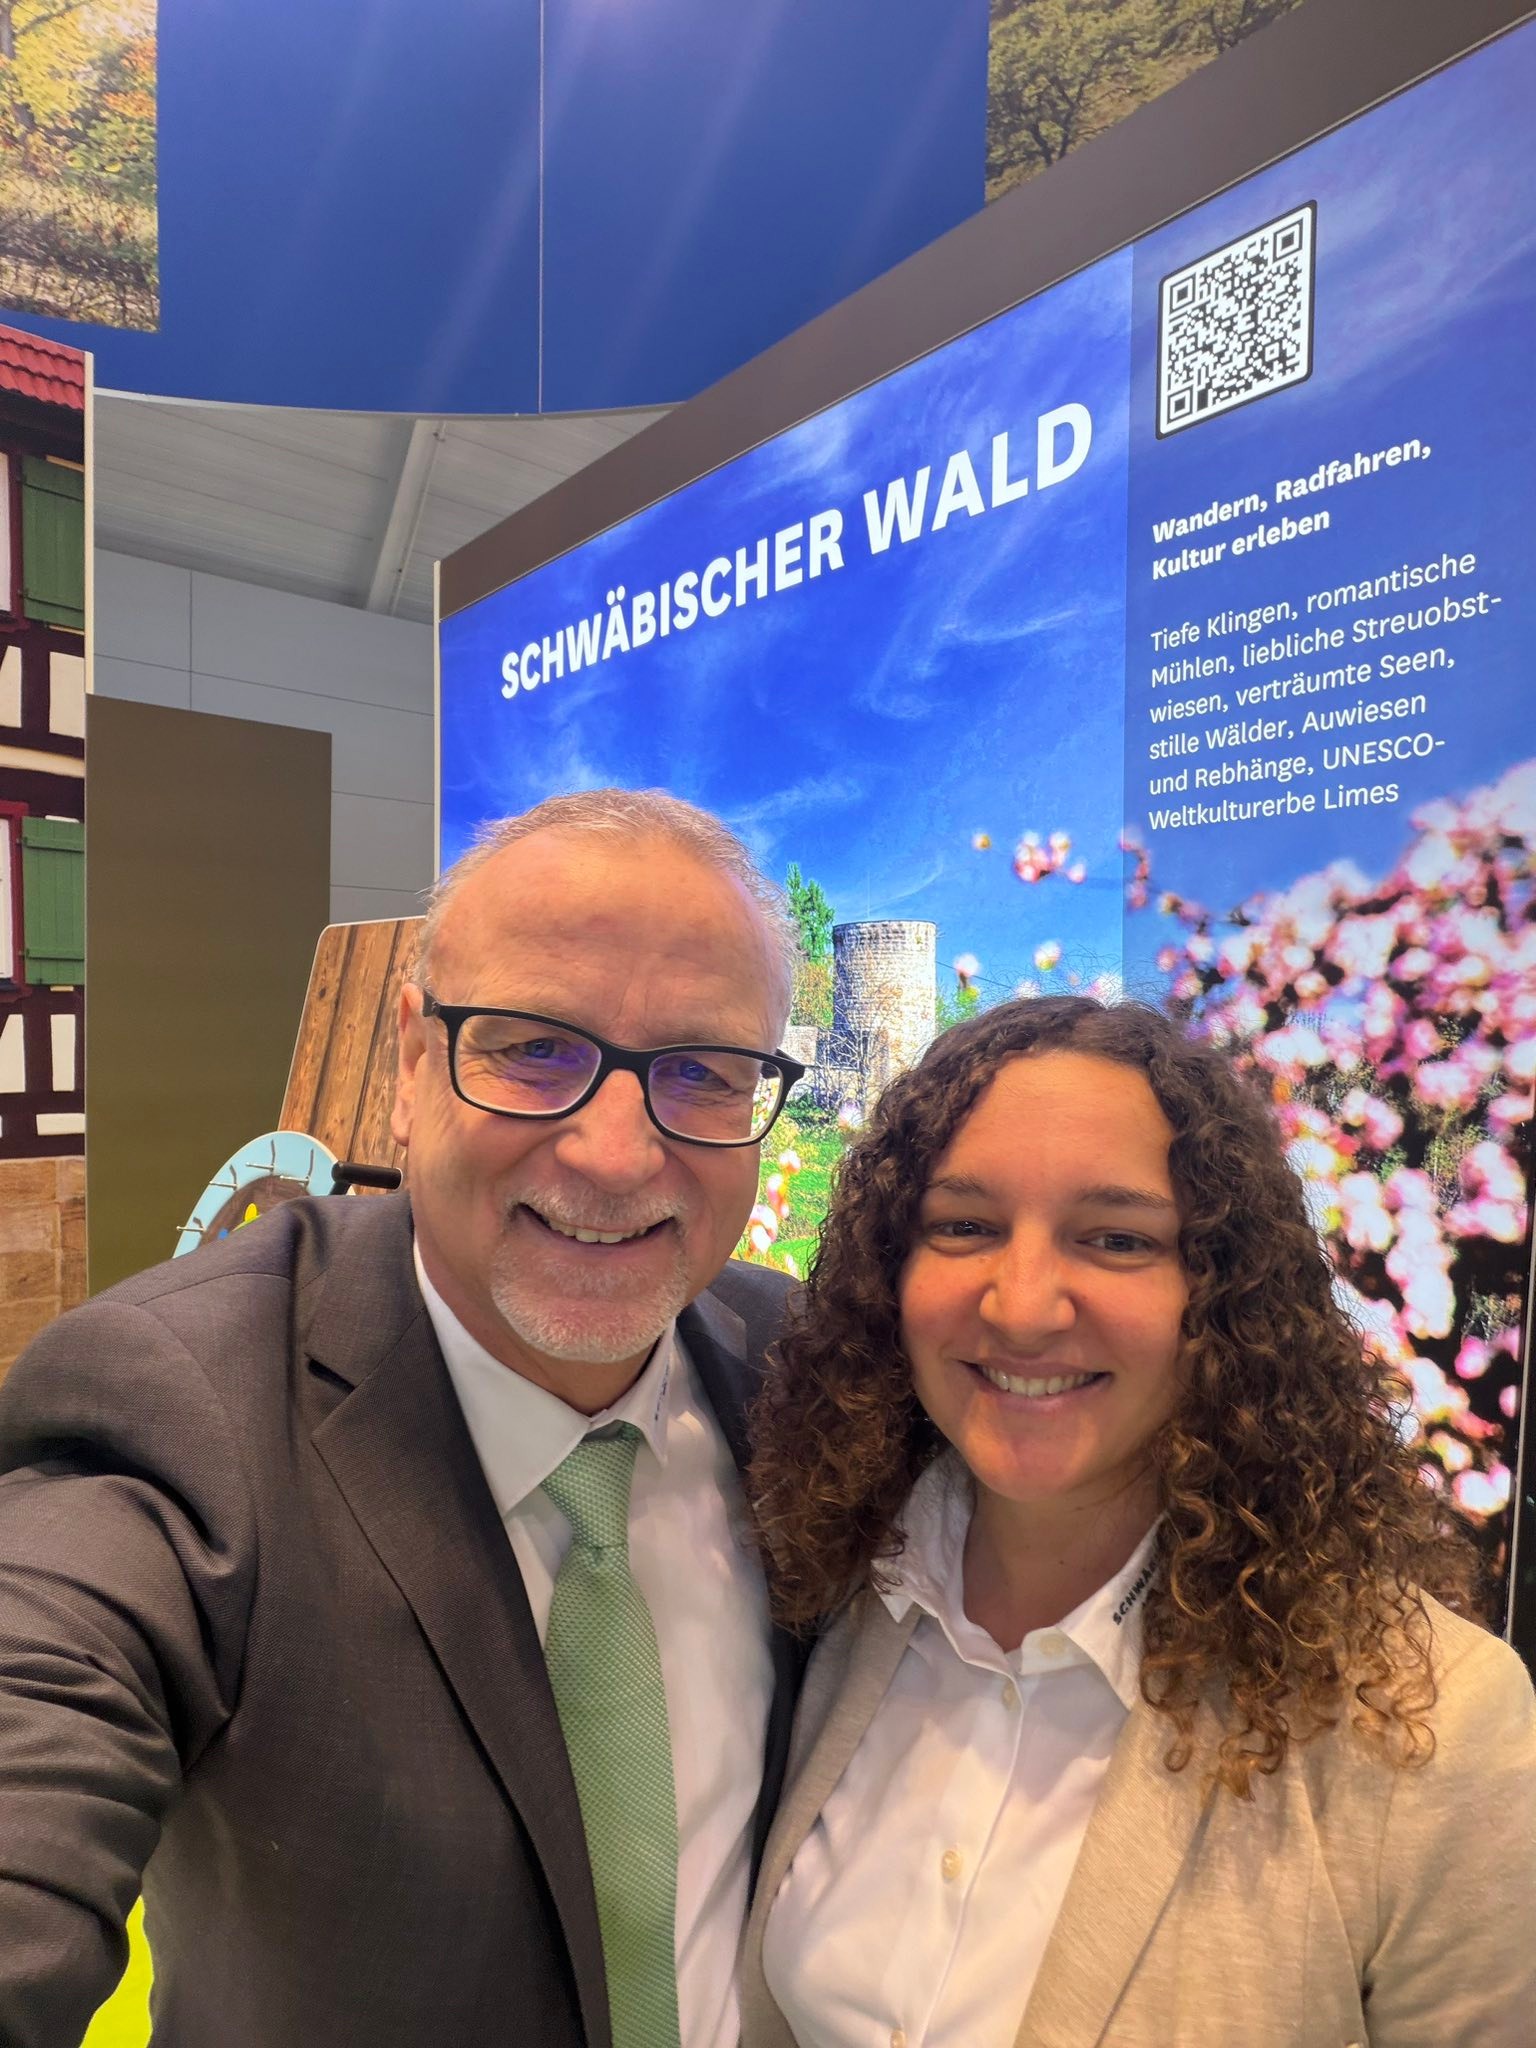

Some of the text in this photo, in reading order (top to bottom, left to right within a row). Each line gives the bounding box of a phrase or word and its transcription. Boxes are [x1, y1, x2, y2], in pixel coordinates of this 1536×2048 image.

[1153, 440, 1431, 543] Wandern, Radfahren,
[501, 402, 1092, 698] SCHWÄBISCHER WALD
[1153, 511, 1330, 580] Kultur erleben
[1151, 554, 1476, 652] Tiefe Klingen, romantische
[1152, 591, 1502, 688] Mühlen, liebliche Streuobst-
[1150, 648, 1455, 724] wiesen, verträumte Seen,
[1149, 694, 1427, 759] stille Wälder, Auwiesen
[1150, 733, 1446, 795] und Rebhänge, UNESCO-
[1149, 784, 1399, 830] Weltkulturerbe Limes
